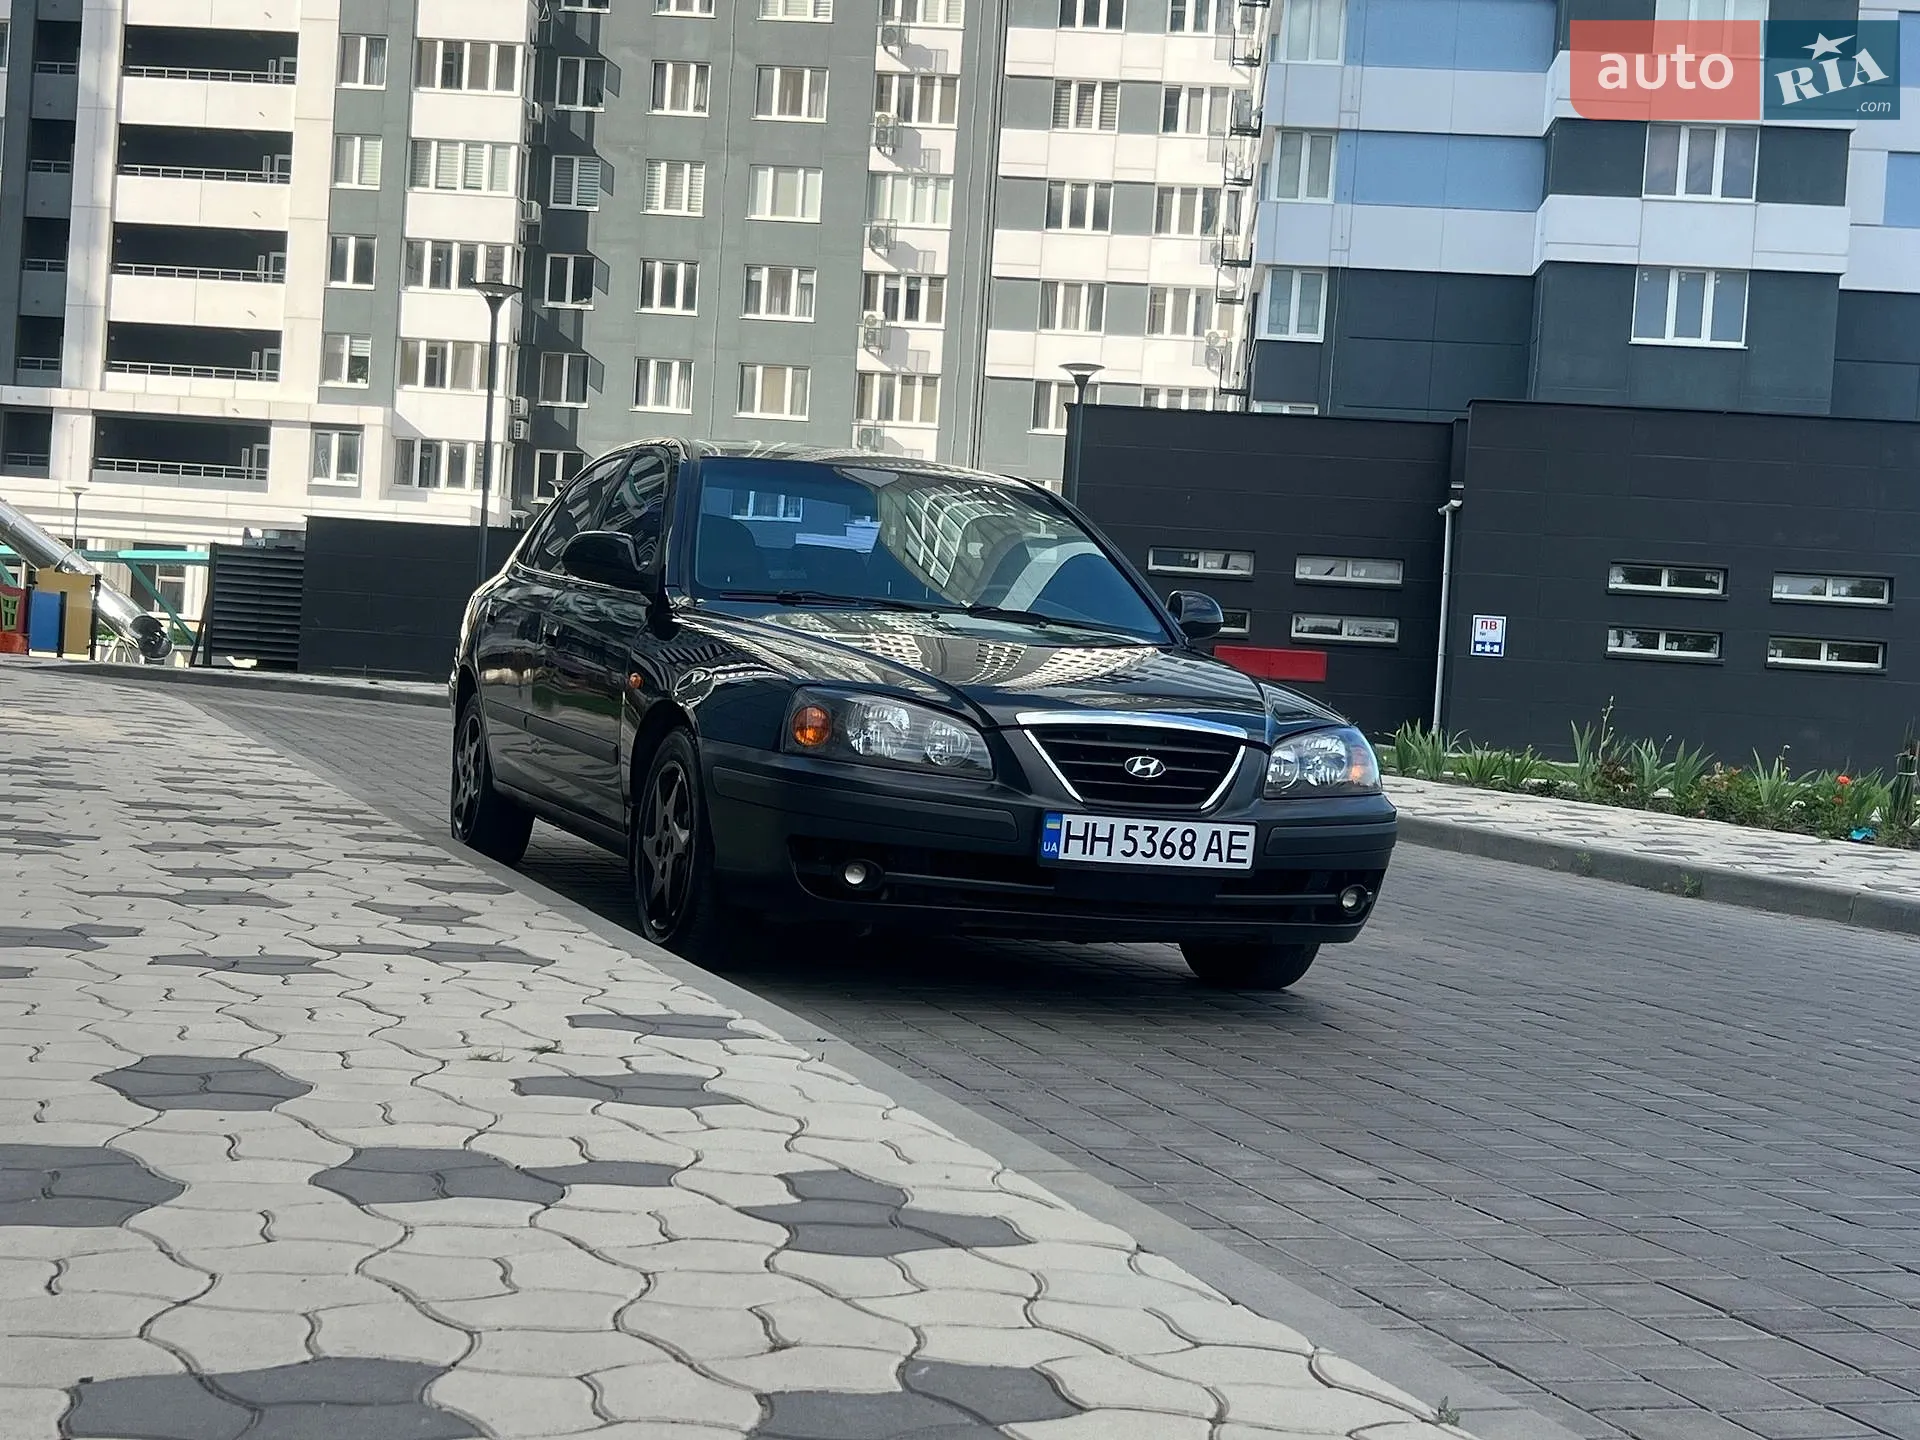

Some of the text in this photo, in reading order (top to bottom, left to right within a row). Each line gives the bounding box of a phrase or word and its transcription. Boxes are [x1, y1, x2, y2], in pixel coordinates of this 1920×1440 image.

[1043, 841, 1058, 853] UA
[1063, 820, 1250, 864] HH 5368 AE
